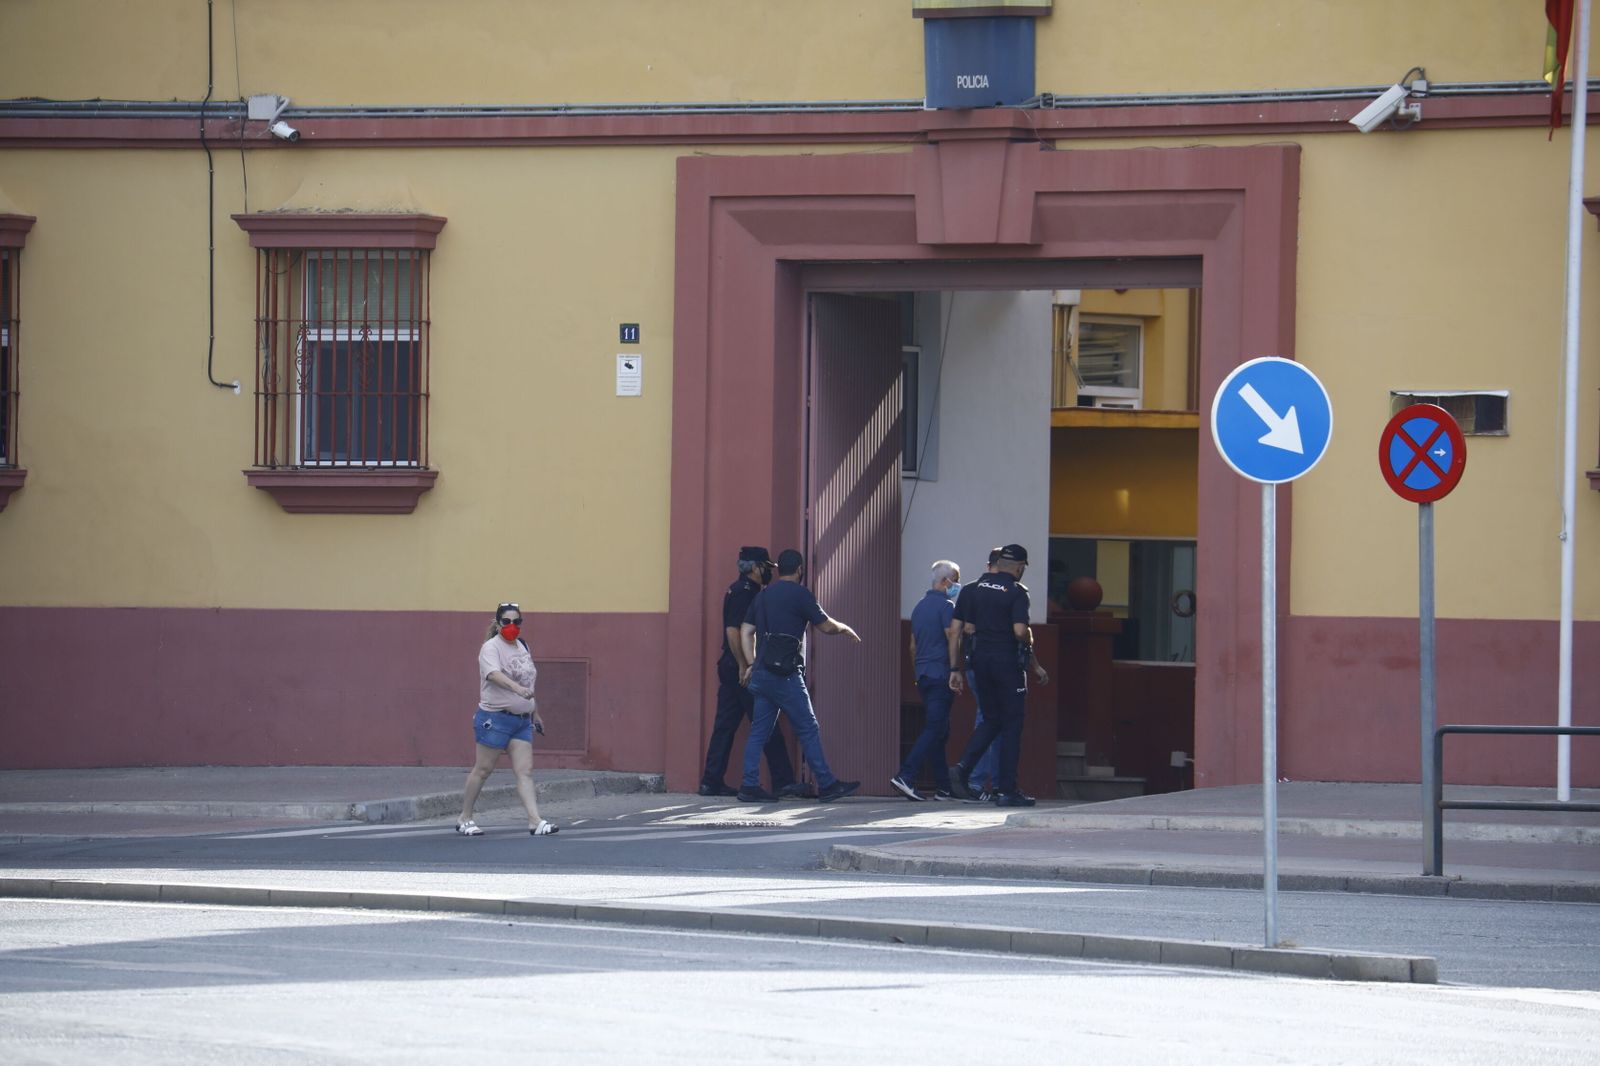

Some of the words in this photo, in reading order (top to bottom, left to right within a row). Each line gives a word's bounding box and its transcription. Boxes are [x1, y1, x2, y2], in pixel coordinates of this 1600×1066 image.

[957, 75, 989, 88] POLICIA
[624, 327, 635, 340] 11
[977, 582, 1005, 592] POLICIA
